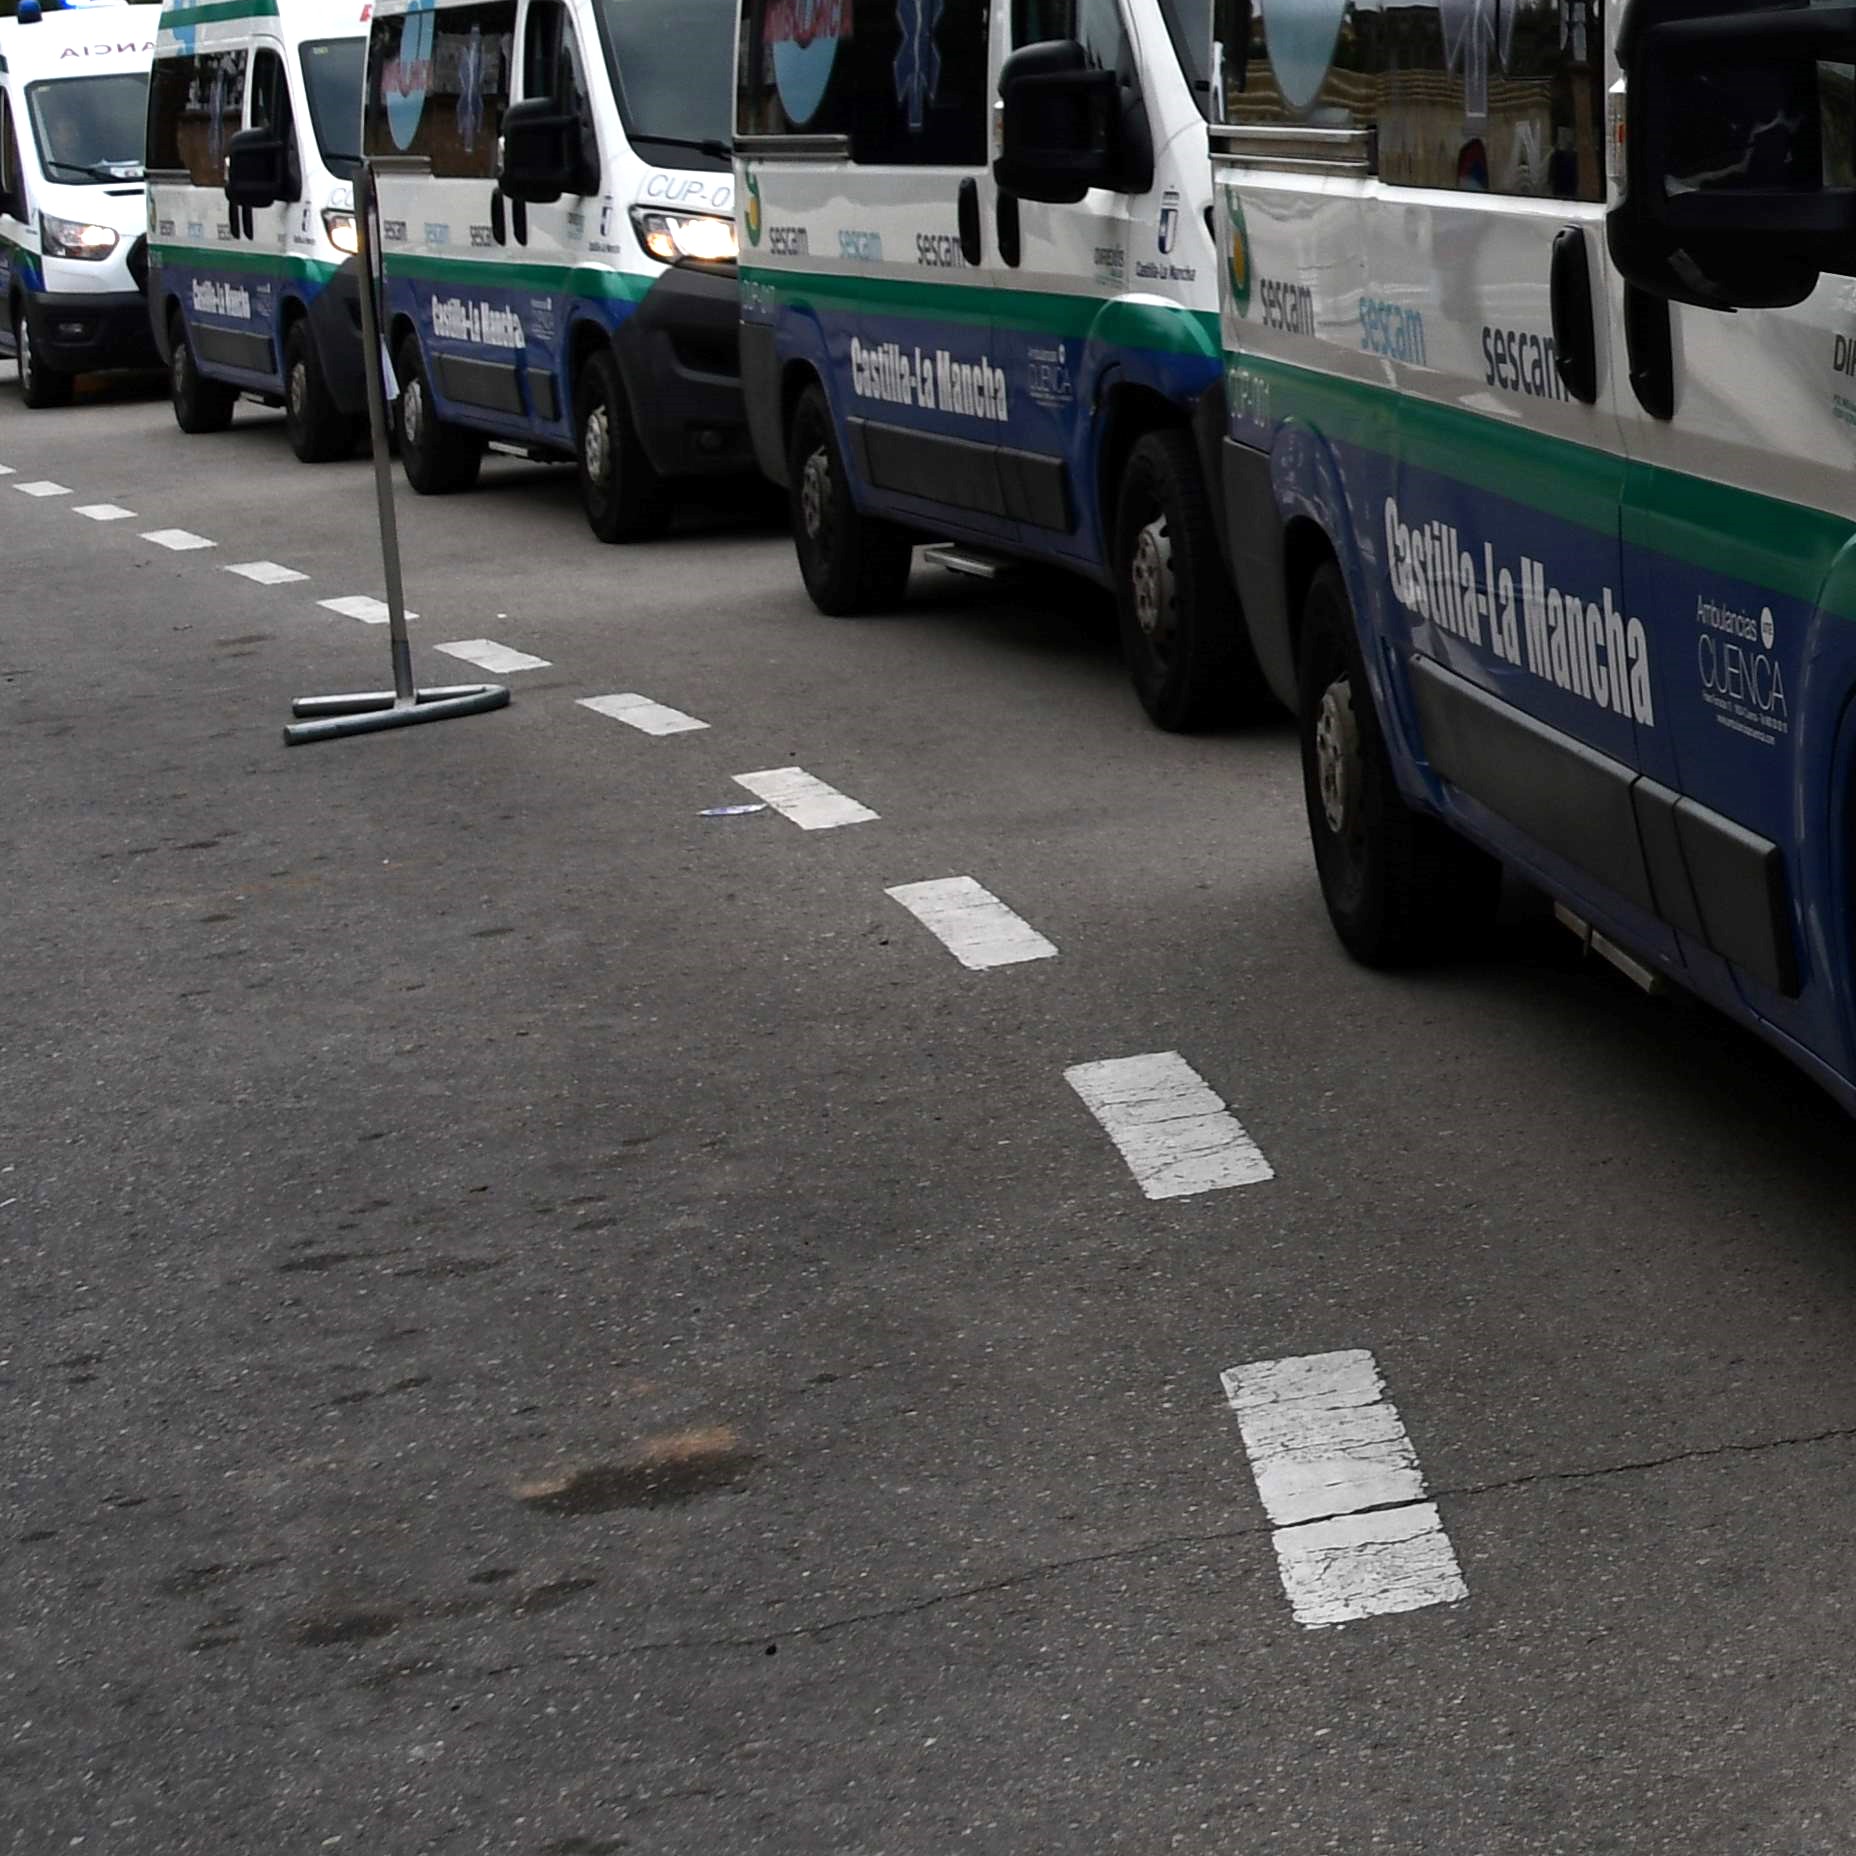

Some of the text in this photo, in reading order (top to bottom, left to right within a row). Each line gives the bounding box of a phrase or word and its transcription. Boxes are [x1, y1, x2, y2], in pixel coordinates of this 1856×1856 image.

[1260, 277, 1315, 337] sescam
[1359, 296, 1427, 367] sescam
[851, 336, 1009, 422] Castilla-La Mancha
[1384, 497, 1655, 728] Castilla-La Mancha
[1698, 634, 1788, 718] CUENCA
